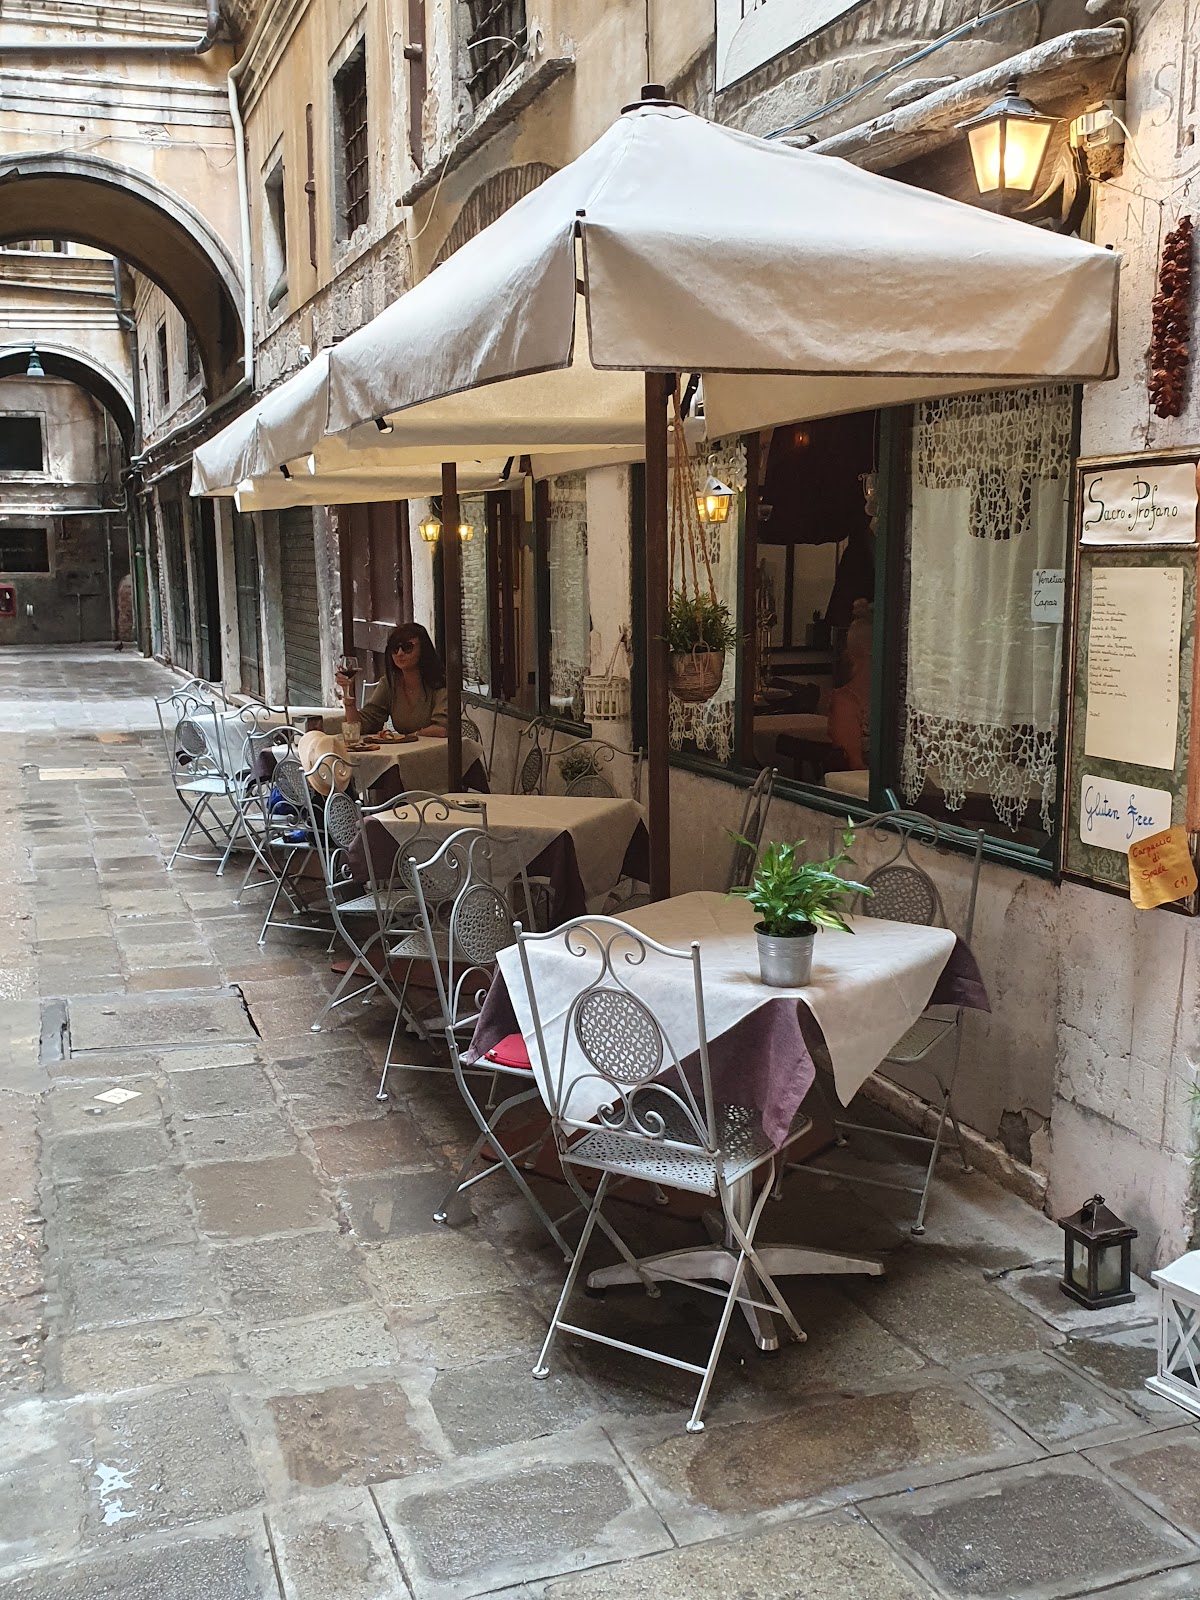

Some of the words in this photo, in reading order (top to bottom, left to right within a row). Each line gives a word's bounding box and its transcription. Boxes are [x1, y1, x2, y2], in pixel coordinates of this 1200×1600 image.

[1085, 477, 1126, 531] Sacro
[1128, 475, 1178, 531] Profano
[1034, 590, 1058, 611] Tapas
[1084, 786, 1120, 831] Gluten
[1126, 793, 1155, 840] Free
[1132, 836, 1172, 858] Carpaccio
[1152, 852, 1160, 863] di
